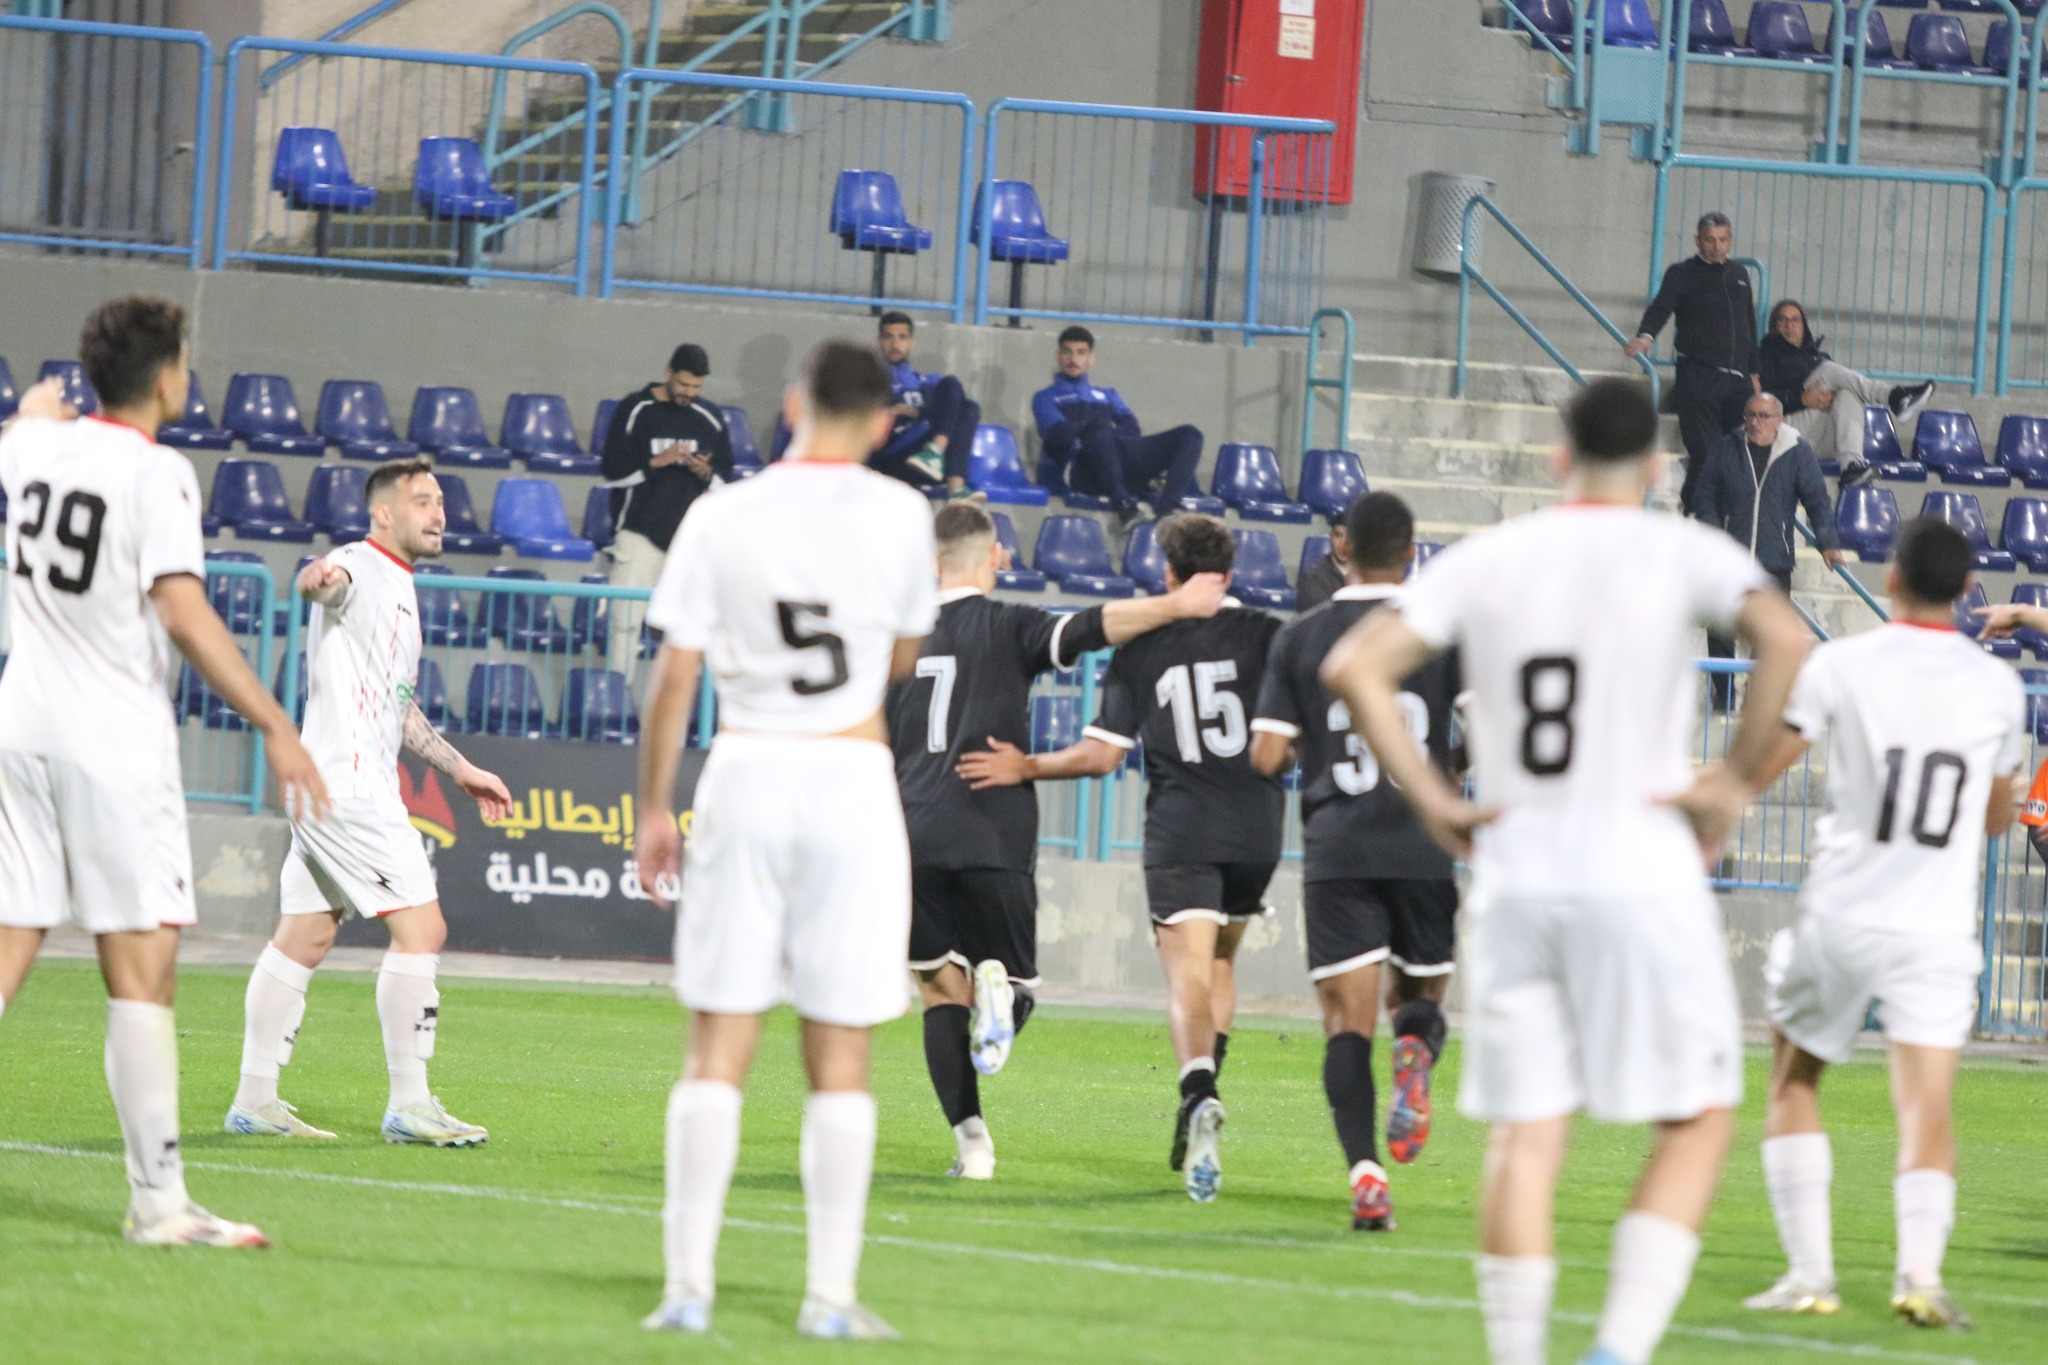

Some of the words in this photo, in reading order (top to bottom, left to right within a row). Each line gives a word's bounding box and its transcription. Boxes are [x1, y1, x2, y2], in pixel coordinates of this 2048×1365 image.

[16, 480, 107, 595] 29
[776, 600, 850, 696] 5
[915, 655, 957, 753] 7
[1155, 659, 1247, 764] 15
[1520, 656, 1578, 776] 8
[1876, 747, 1967, 849] 10
[486, 851, 611, 904] محلية
